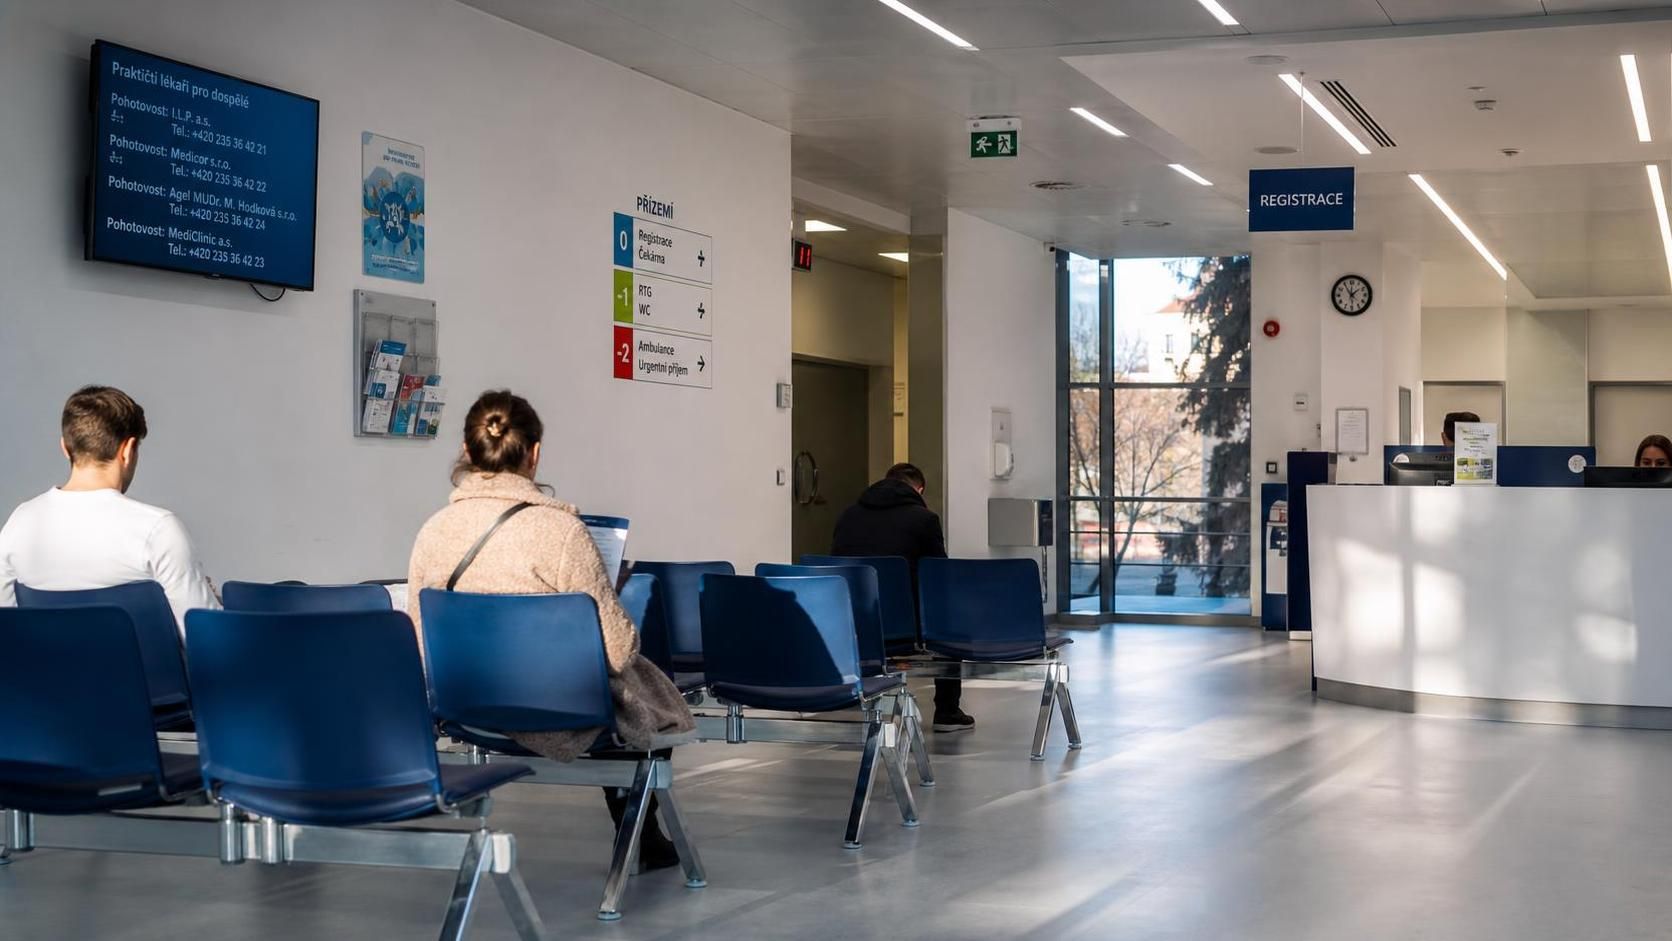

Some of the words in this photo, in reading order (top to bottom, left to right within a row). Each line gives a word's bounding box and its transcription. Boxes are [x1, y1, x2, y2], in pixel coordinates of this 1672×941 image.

[192, 85, 209, 99] pro
[111, 92, 168, 117] Pohotovost:
[196, 115, 211, 127] a.s.
[171, 123, 190, 138] Tel.:
[192, 130, 214, 144] +420
[216, 134, 231, 147] 235
[234, 138, 244, 150] 36
[245, 140, 255, 153] 42
[257, 143, 267, 156] 21
[110, 134, 168, 157] Pohotovost:
[171, 147, 209, 166] Medicor
[210, 158, 231, 170] s.r.o.
[170, 163, 189, 177] Tel.:
[191, 169, 213, 182] +420
[215, 172, 230, 186] 235
[233, 176, 243, 188] 36
[244, 178, 255, 190] 42
[257, 181, 267, 193] 22
[108, 175, 167, 197] Pohotovost:
[169, 187, 191, 202] Agel
[193, 191, 222, 207] MUDr.
[224, 197, 235, 210] M.
[238, 199, 276, 217] Hodková
[277, 211, 297, 222] s.r.o.
[636, 194, 674, 220] PŘÍZEMÍ
[1260, 193, 1344, 207] REGISTRACE
[169, 203, 188, 216] Tel.:
[190, 208, 212, 221] +420
[213, 211, 229, 224] 235
[231, 214, 242, 226] 36
[243, 217, 254, 229] 42
[255, 219, 266, 231] 24
[107, 216, 166, 237] Pohotovost:
[168, 226, 216, 246] MediClinic
[218, 237, 233, 248] a.s.
[619, 230, 628, 251] 0
[638, 229, 673, 248] Registrace
[168, 243, 187, 256] Tel.:
[189, 247, 211, 260] +420
[212, 250, 228, 262] 235
[230, 252, 241, 264] 36
[242, 254, 253, 266] 42
[254, 256, 265, 268] 23
[617, 287, 628, 307] -1
[638, 284, 652, 298] RTG
[638, 303, 651, 316] WC
[617, 343, 630, 363] -2
[638, 340, 675, 356] Ambulance
